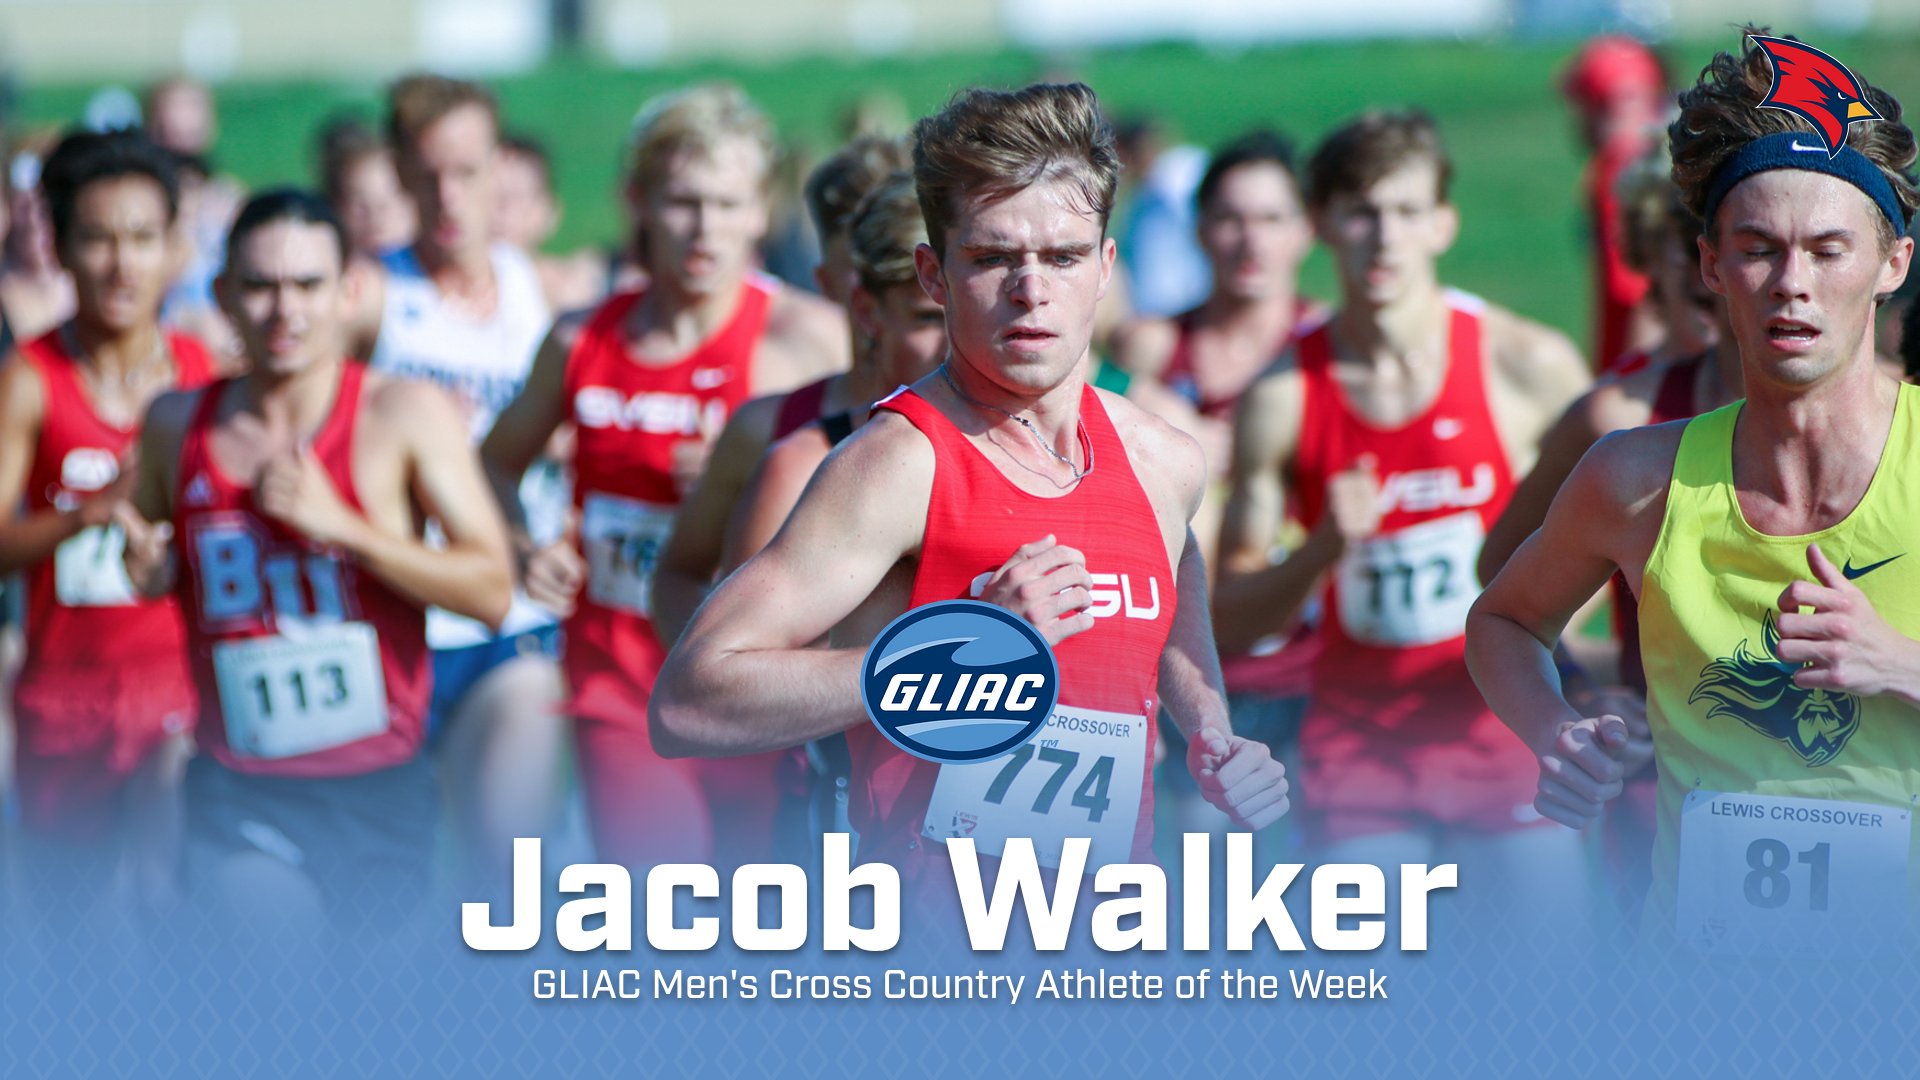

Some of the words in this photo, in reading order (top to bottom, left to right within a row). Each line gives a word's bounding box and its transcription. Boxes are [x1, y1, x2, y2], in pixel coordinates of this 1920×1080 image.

[1375, 463, 1495, 514] VSU
[198, 526, 348, 622] BU
[249, 664, 348, 718] 113
[1046, 713, 1131, 738] CROSSOVER
[983, 742, 1115, 823] 774
[1711, 801, 1766, 819] LEWIS
[1770, 806, 1883, 828] CROSSOVER
[1743, 837, 1831, 912] 81
